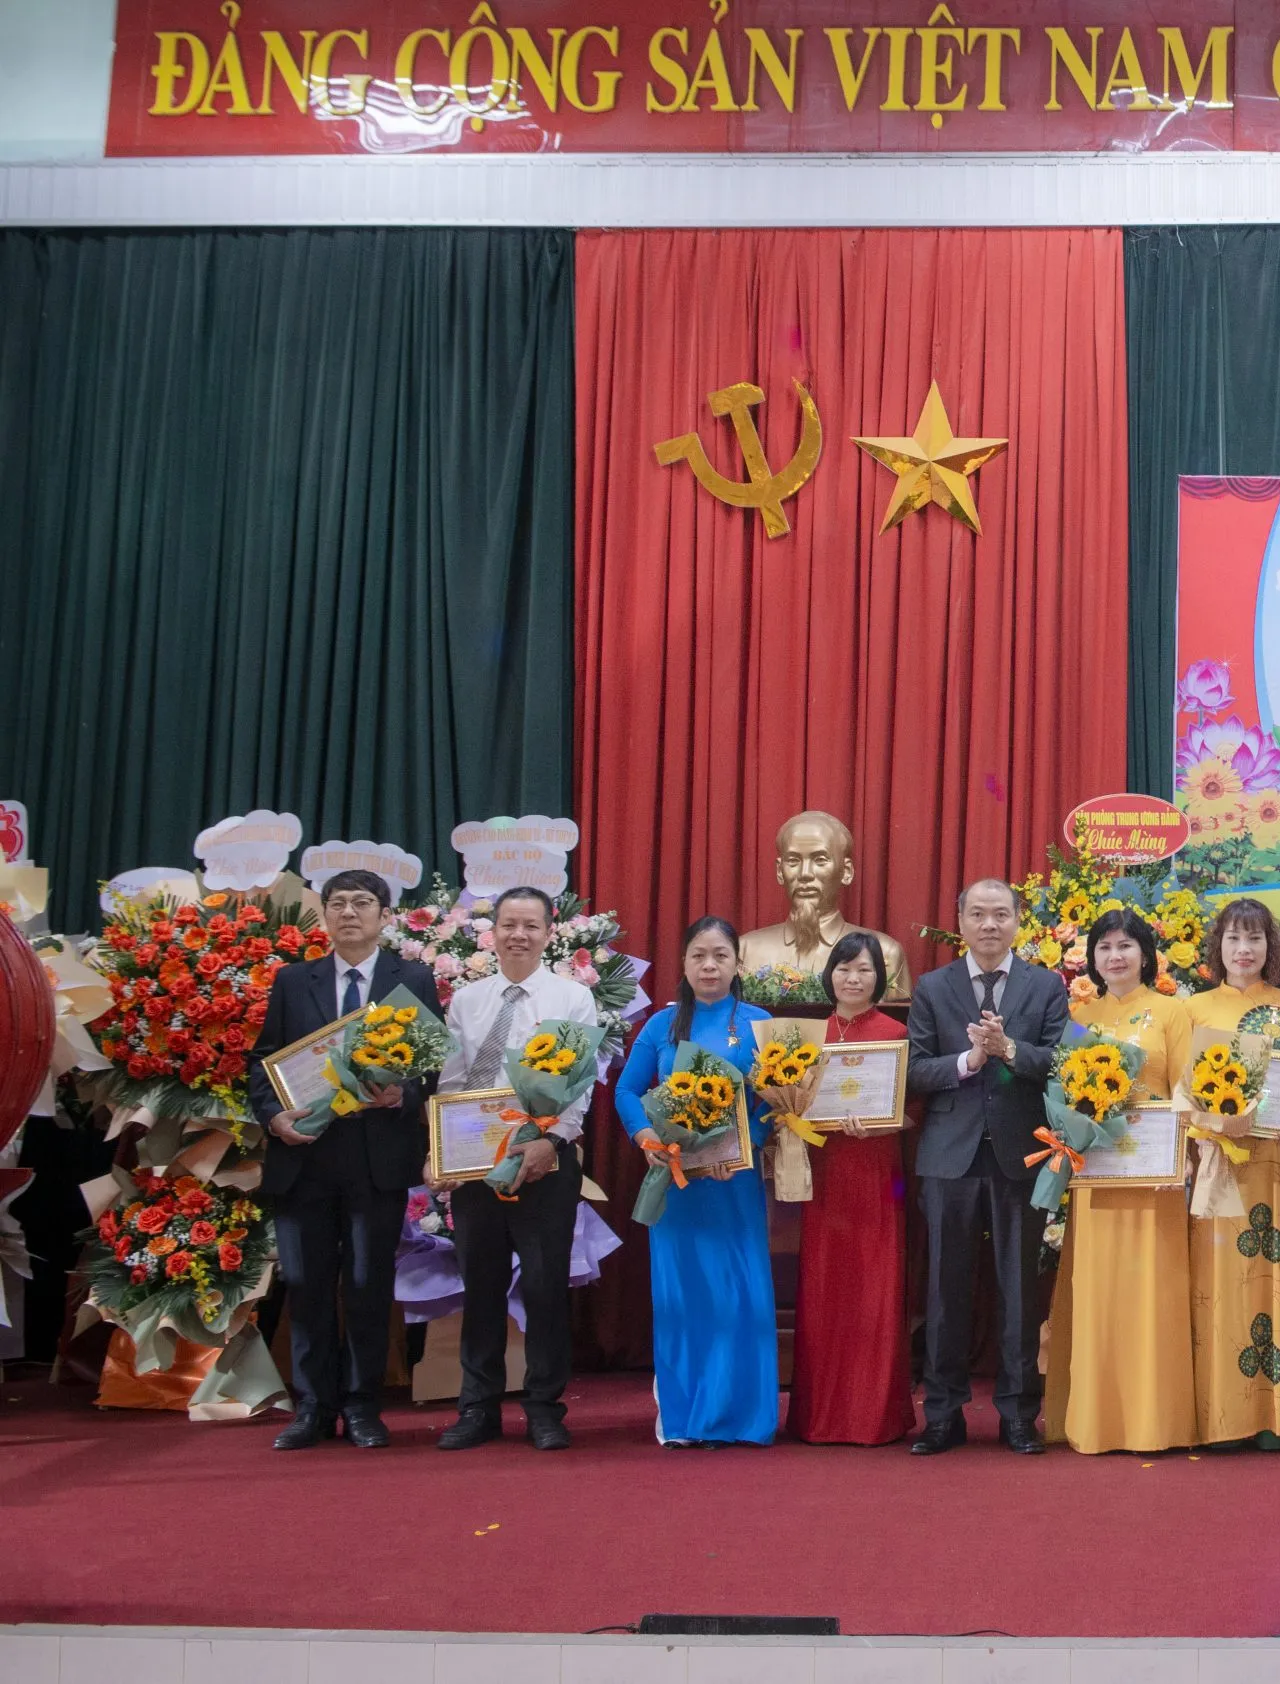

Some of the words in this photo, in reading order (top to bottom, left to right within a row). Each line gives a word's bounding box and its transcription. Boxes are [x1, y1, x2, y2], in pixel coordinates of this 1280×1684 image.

[147, 0, 369, 117] ĐẢNG
[394, 2, 623, 132] CỘNG
[645, 0, 803, 113] SẢN
[824, 3, 1020, 129] VIỆT
[1044, 26, 1234, 113] NAM
[1087, 829, 1123, 851] Chúc
[1124, 829, 1167, 855] Mừng
